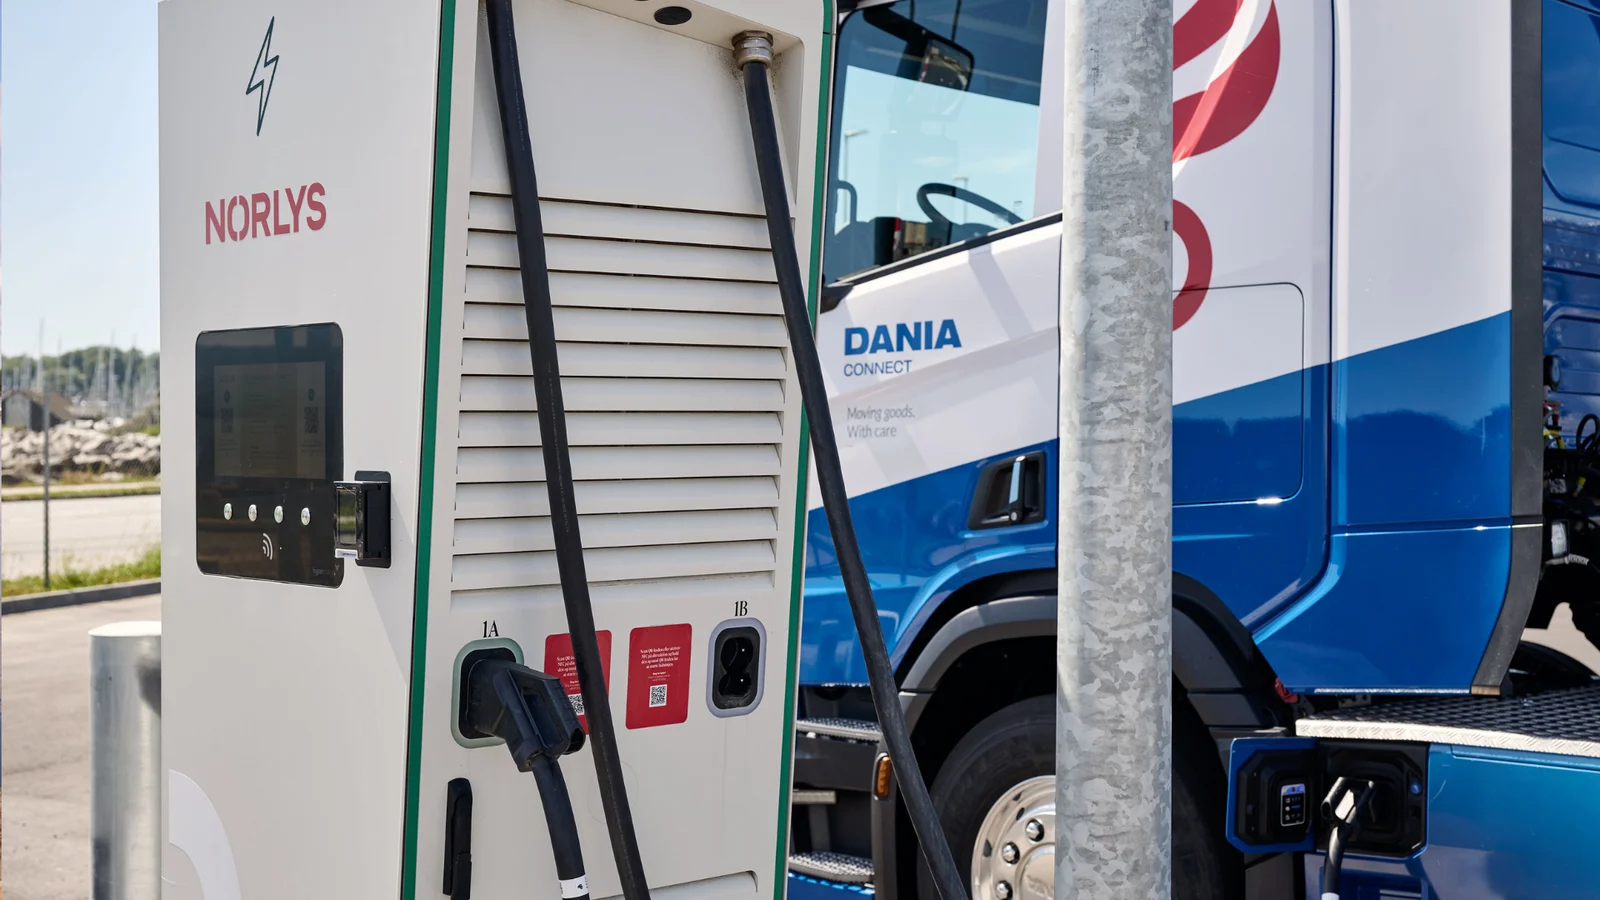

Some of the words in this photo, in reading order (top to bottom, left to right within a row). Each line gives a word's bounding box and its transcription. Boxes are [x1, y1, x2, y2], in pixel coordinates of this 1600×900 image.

[205, 182, 327, 245] NORLYS
[844, 318, 962, 356] DANIA
[843, 359, 912, 377] CONNECT
[846, 406, 882, 422] Moving
[883, 404, 916, 422] goods.
[846, 424, 873, 438] With
[874, 426, 897, 438] care
[734, 600, 748, 617] 1B
[482, 620, 499, 638] 1A
